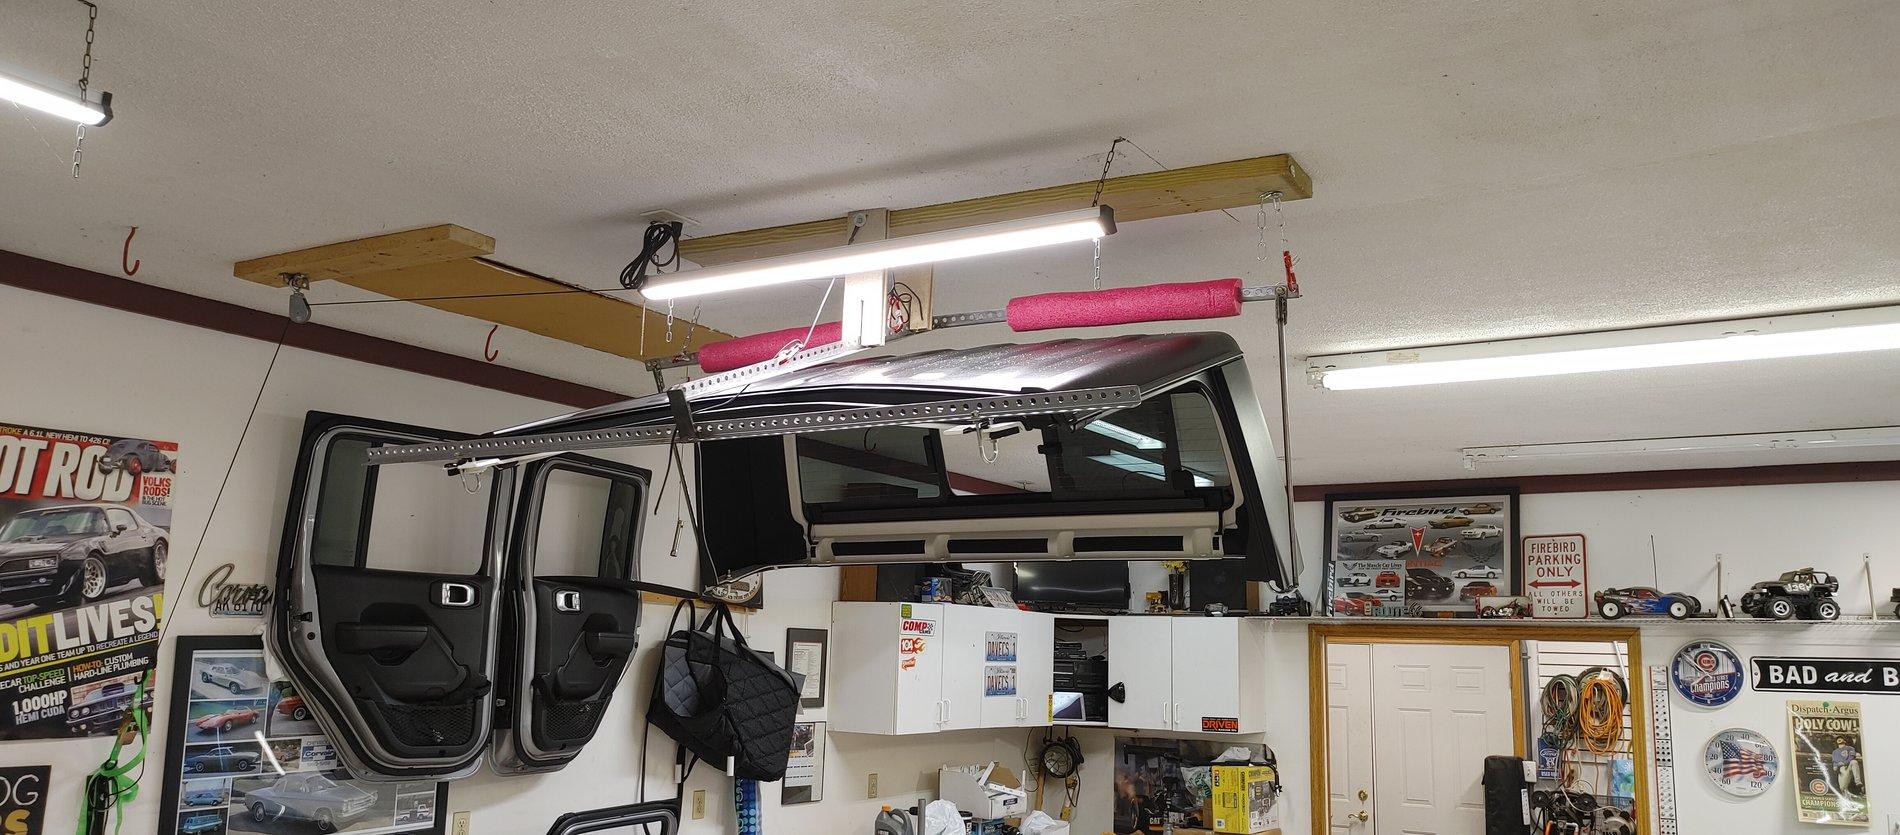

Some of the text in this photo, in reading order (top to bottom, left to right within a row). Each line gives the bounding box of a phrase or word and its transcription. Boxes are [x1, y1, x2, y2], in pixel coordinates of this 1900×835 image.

[46, 431, 62, 440] NEW
[63, 433, 79, 442] HEMI
[79, 435, 89, 444] TO
[89, 436, 102, 445] 426
[143, 476, 172, 488] VOLKS
[143, 486, 171, 498] RODS!
[1381, 507, 1460, 517] Firebird
[1531, 542, 1576, 553] FIREBIRD
[1528, 554, 1581, 566] PARKING
[1537, 567, 1573, 578] ONLY
[903, 621, 928, 631] COMP
[4, 661, 20, 672] AND
[20, 656, 40, 669] YEAR
[40, 653, 56, 663] ONE
[57, 649, 76, 660] TEAM
[77, 646, 86, 656] UP
[86, 644, 96, 653] TO
[95, 638, 128, 651] RECREATE
[104, 653, 134, 665] CUSTOM
[73, 656, 149, 681] HARD-LINE PLUMBING
[0, 668, 65, 690] ECAR TOP-SPEED
[1769, 665, 1818, 685] BAD
[1824, 668, 1873, 684] and
[18, 676, 66, 694] CHALLENGE
[12, 690, 68, 716] 1,000HP
[16, 705, 66, 725] HEMI CUDA
[1203, 720, 1238, 729] DRIVEN
[1796, 718, 1859, 731] HOLY COW!
